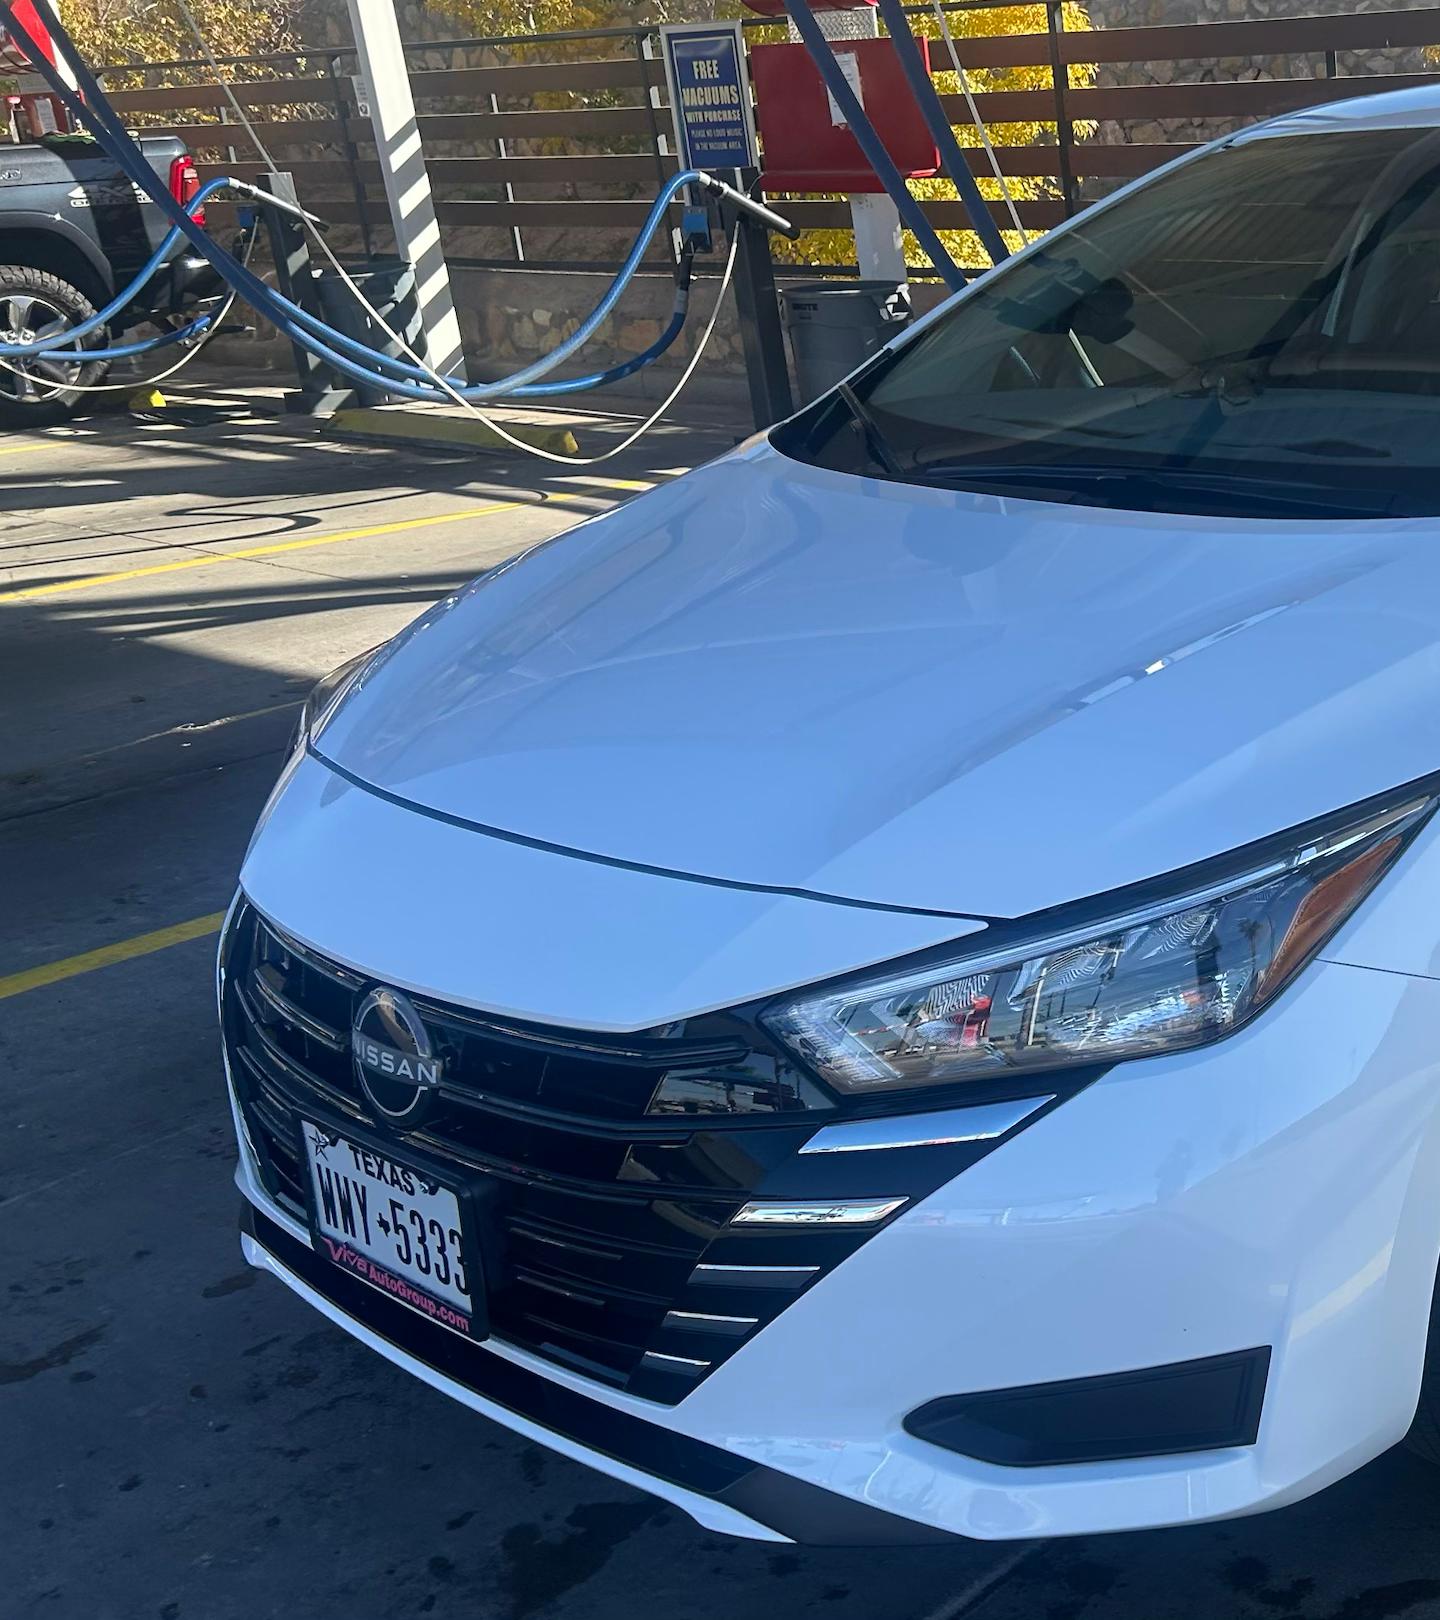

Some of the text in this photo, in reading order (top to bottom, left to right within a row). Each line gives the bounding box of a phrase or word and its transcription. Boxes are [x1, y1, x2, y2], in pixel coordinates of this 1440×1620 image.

[692, 60, 720, 80] FREE
[682, 85, 739, 106] VACUUMS
[684, 109, 741, 123] WITH PURCHASE
[353, 1035, 437, 1084] NISSAN
[348, 1144, 415, 1197] TEXAS
[316, 1163, 471, 1296] WWY 5333
[320, 1234, 469, 1332] Viva AutoGroup.com
